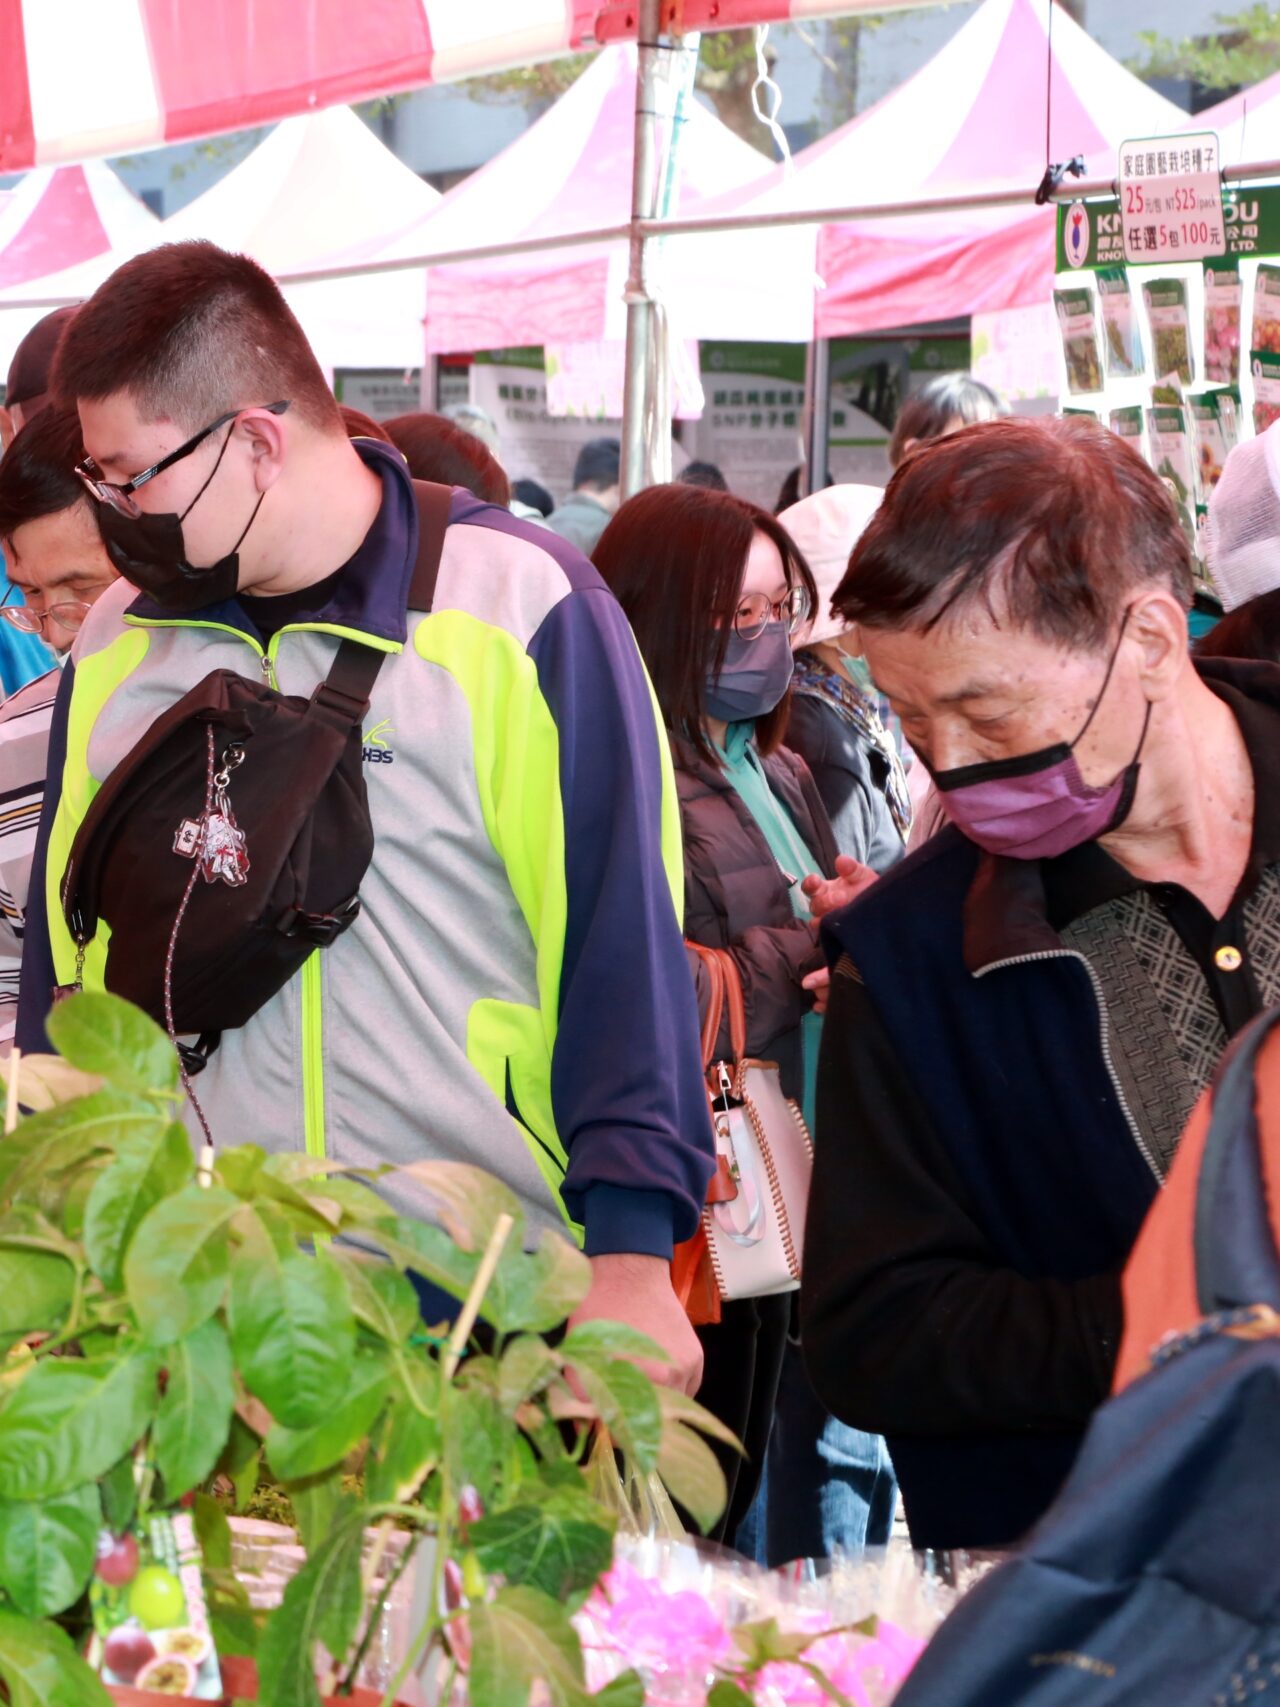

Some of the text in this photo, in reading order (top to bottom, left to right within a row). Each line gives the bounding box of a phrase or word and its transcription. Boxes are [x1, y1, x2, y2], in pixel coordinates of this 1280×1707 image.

[1123, 147, 1214, 178] 家庭園藝栽培種子
